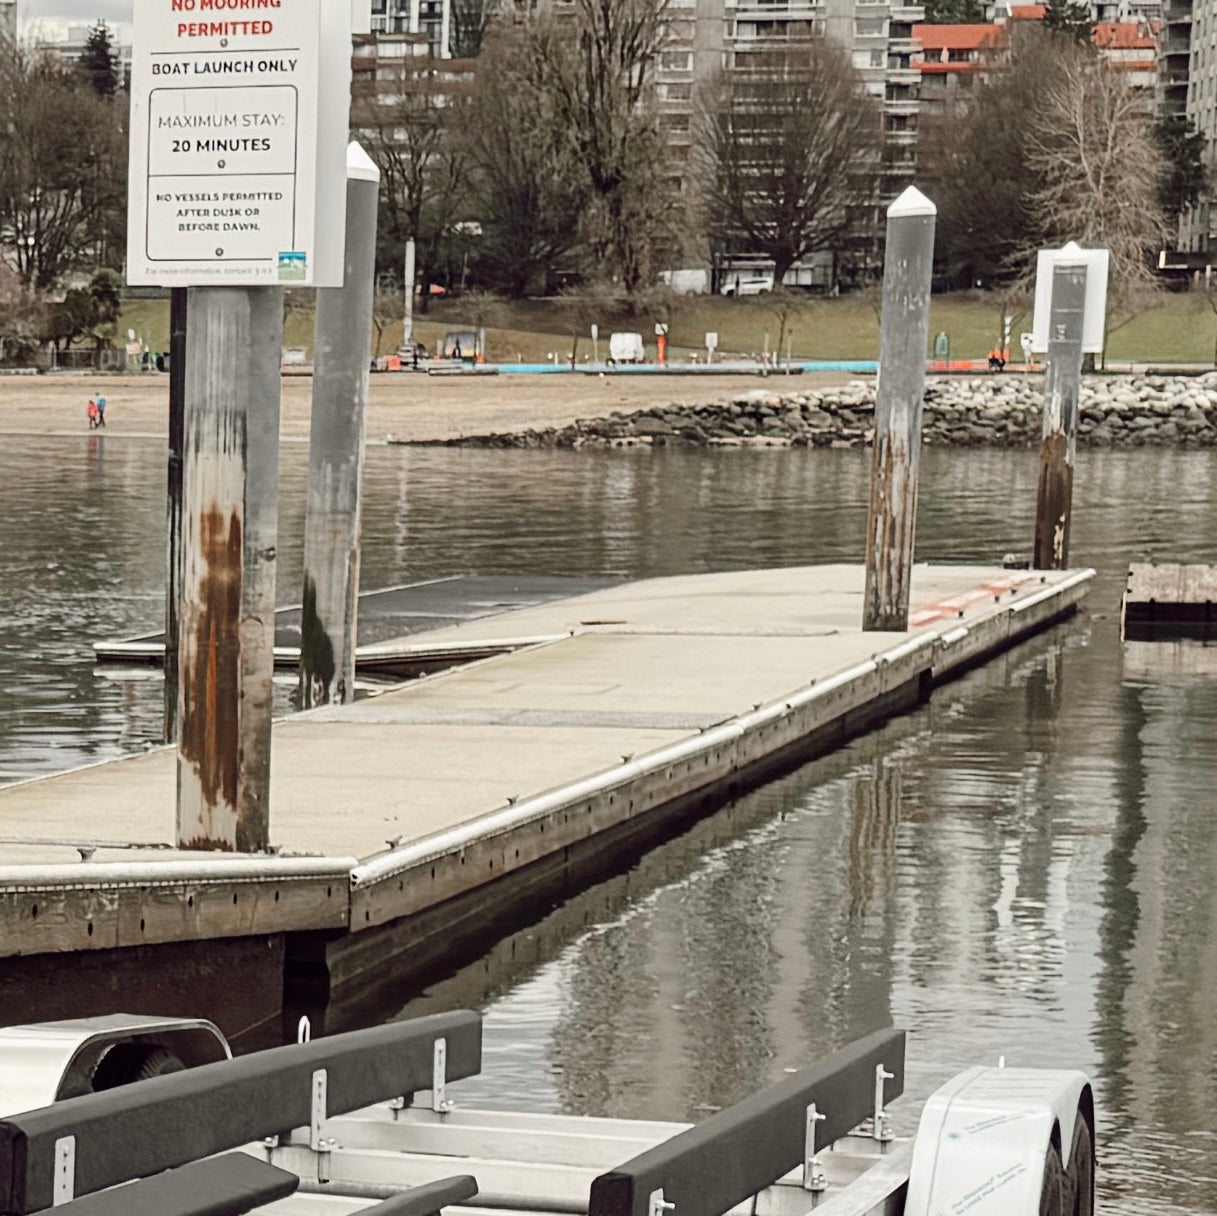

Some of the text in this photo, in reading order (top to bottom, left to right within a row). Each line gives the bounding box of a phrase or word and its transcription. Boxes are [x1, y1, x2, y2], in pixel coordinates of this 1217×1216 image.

[172, 0, 281, 11] NO MOORING
[177, 20, 273, 37] PERMITTED
[152, 59, 298, 75] BOAT LAUNCH ONLY
[158, 114, 237, 128] MAXIMUM
[172, 138, 271, 152] 20 MINUTES
[156, 192, 282, 202] NO VESSELS PERMITTED
[176, 208, 260, 217] AFTER DUSK OR
[178, 223, 219, 231] BEFORE
